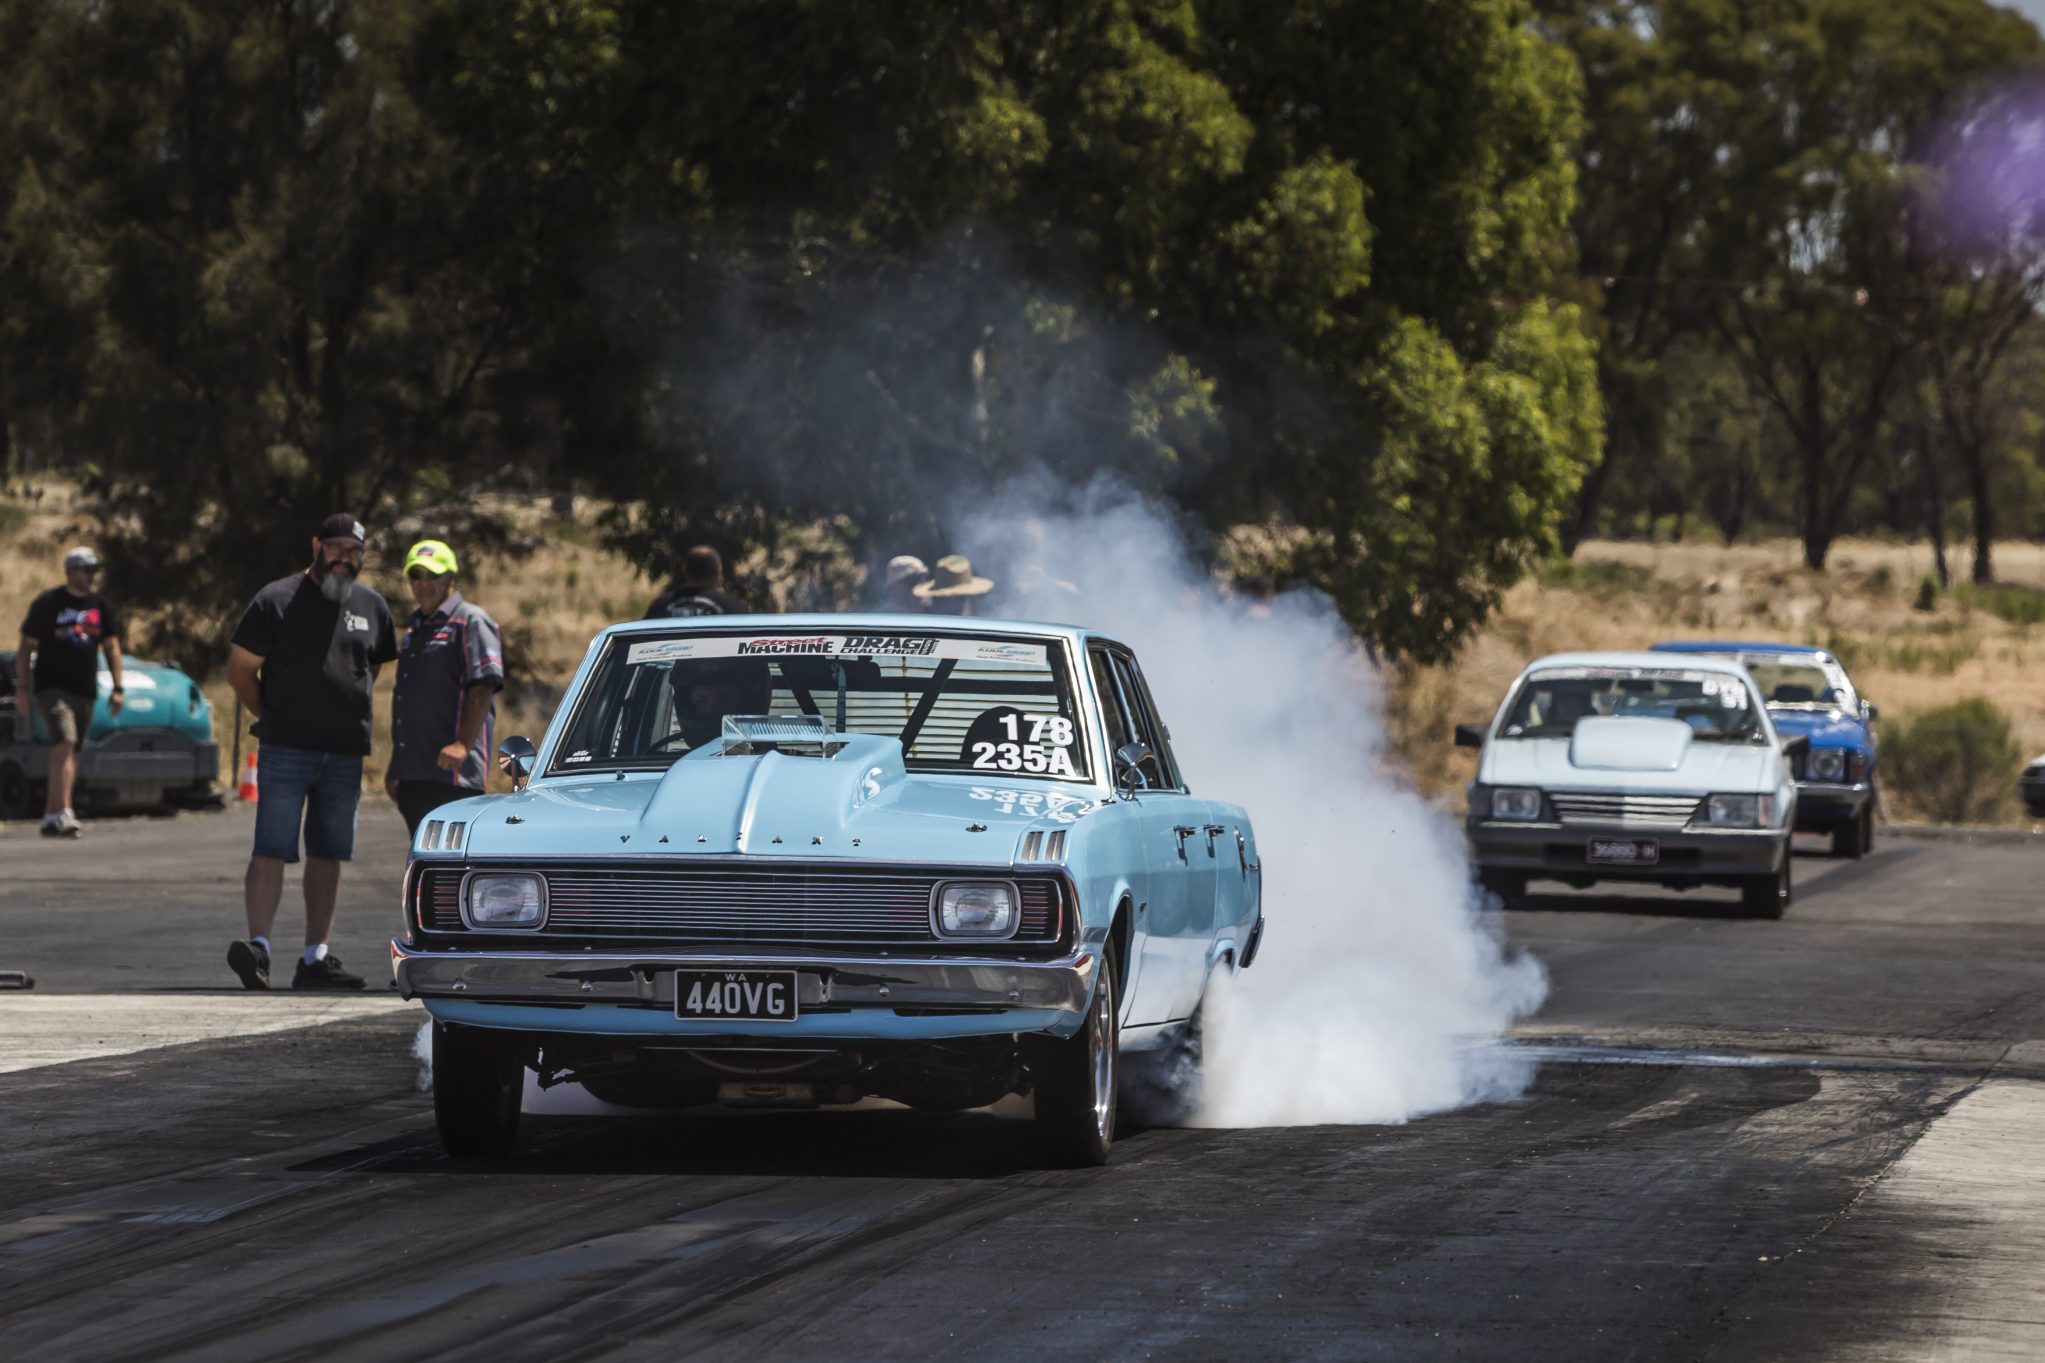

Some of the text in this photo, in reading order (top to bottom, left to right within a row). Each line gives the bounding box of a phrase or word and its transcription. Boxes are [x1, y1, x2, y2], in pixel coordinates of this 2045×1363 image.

[738, 641, 834, 655] MACHINE
[842, 637, 924, 649] DRAG
[999, 714, 1074, 746] 178
[972, 742, 1077, 776] 235A
[725, 973, 747, 981] WA
[686, 981, 785, 1015] 440VG
